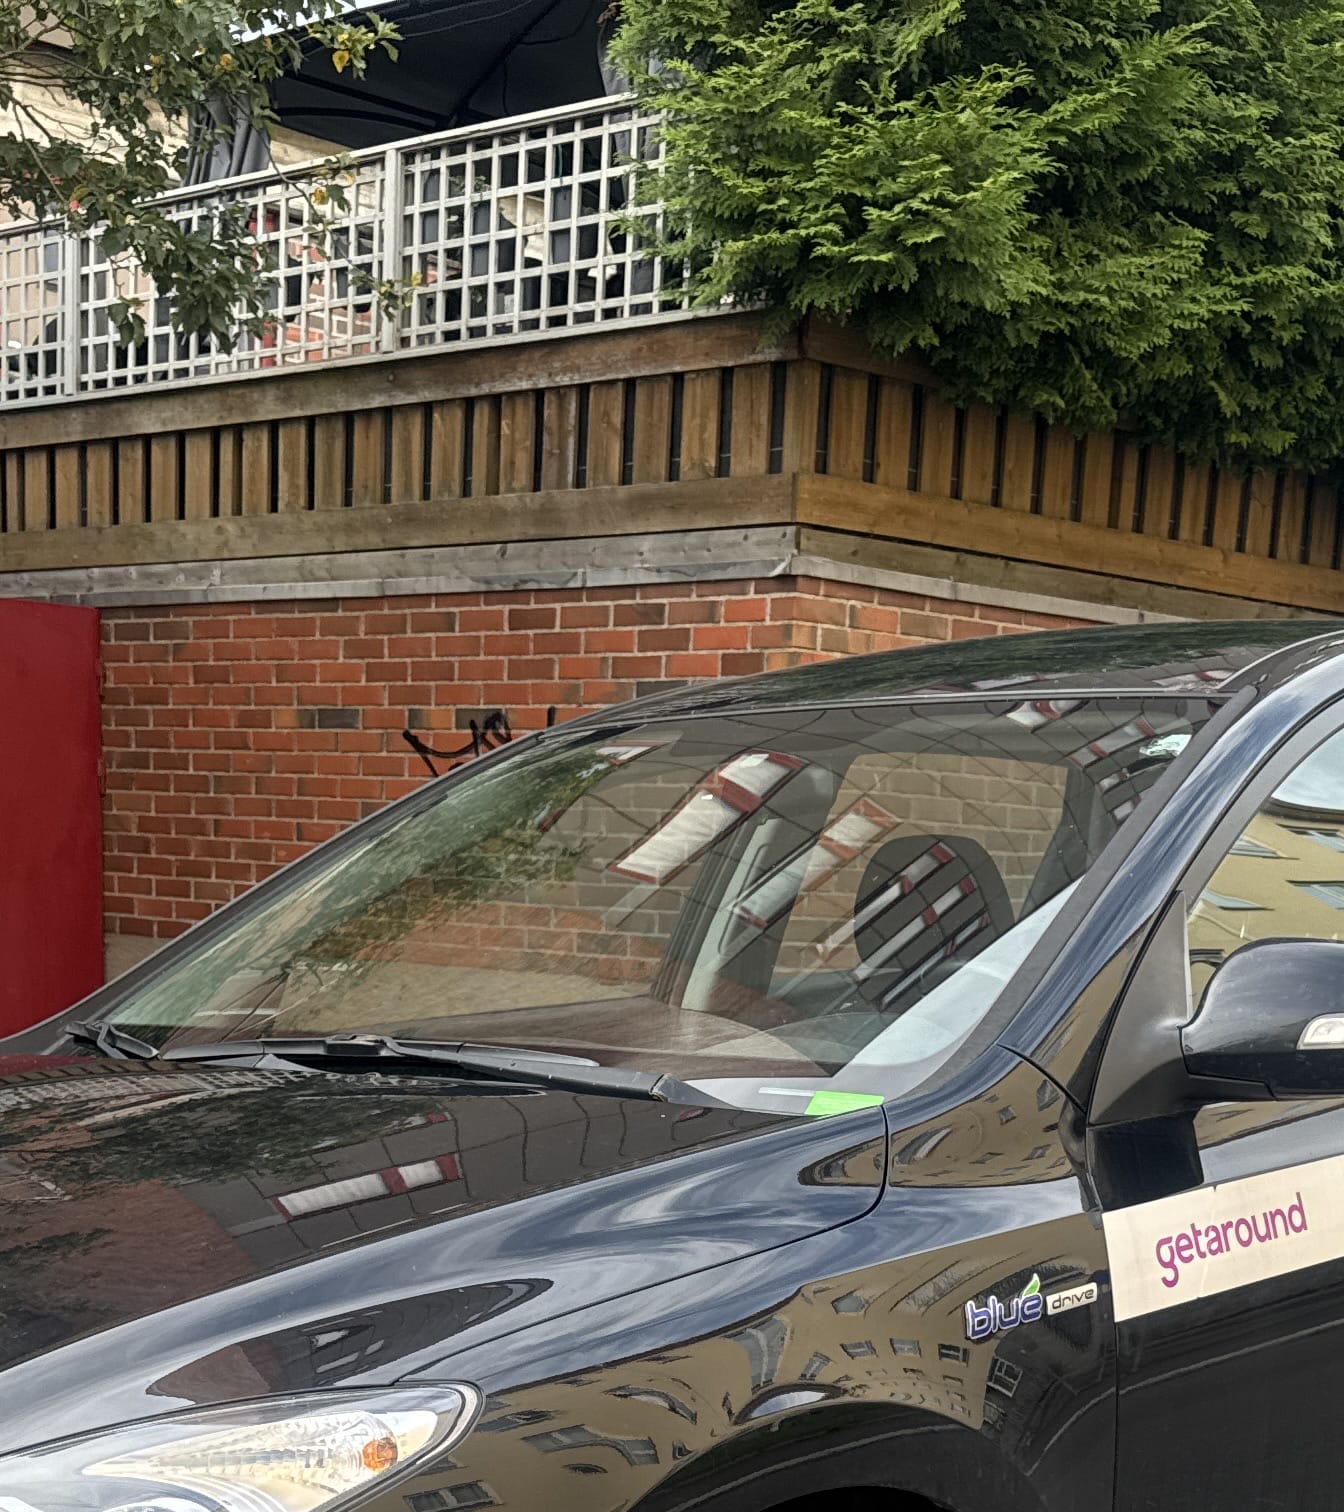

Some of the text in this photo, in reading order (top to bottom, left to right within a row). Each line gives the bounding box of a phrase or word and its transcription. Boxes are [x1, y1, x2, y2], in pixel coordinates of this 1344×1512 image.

[1156, 1191, 1308, 1288] getaround
[965, 1287, 1095, 1340] blue drive
